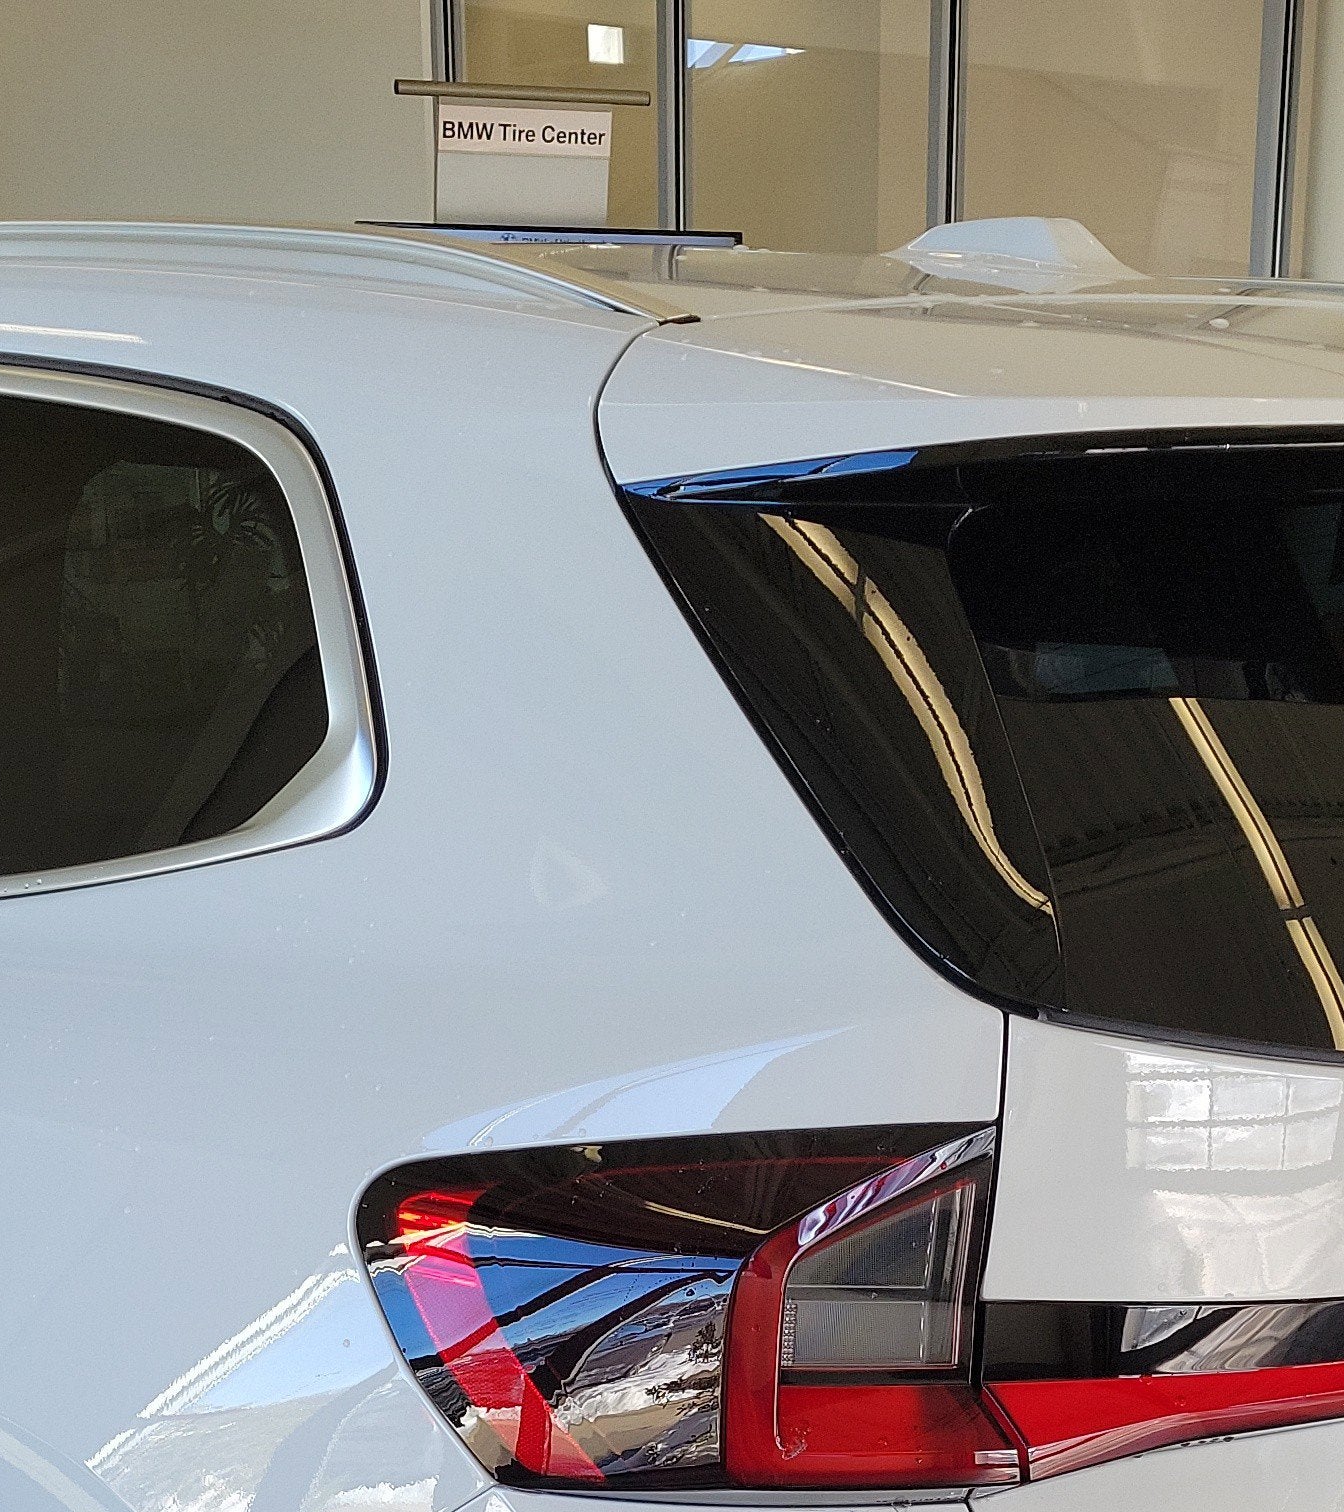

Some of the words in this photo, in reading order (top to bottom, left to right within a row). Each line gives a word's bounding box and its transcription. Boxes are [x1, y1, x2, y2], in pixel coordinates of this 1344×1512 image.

[442, 120, 495, 141] BMW
[498, 123, 536, 143] Tire
[541, 125, 606, 146] Center
